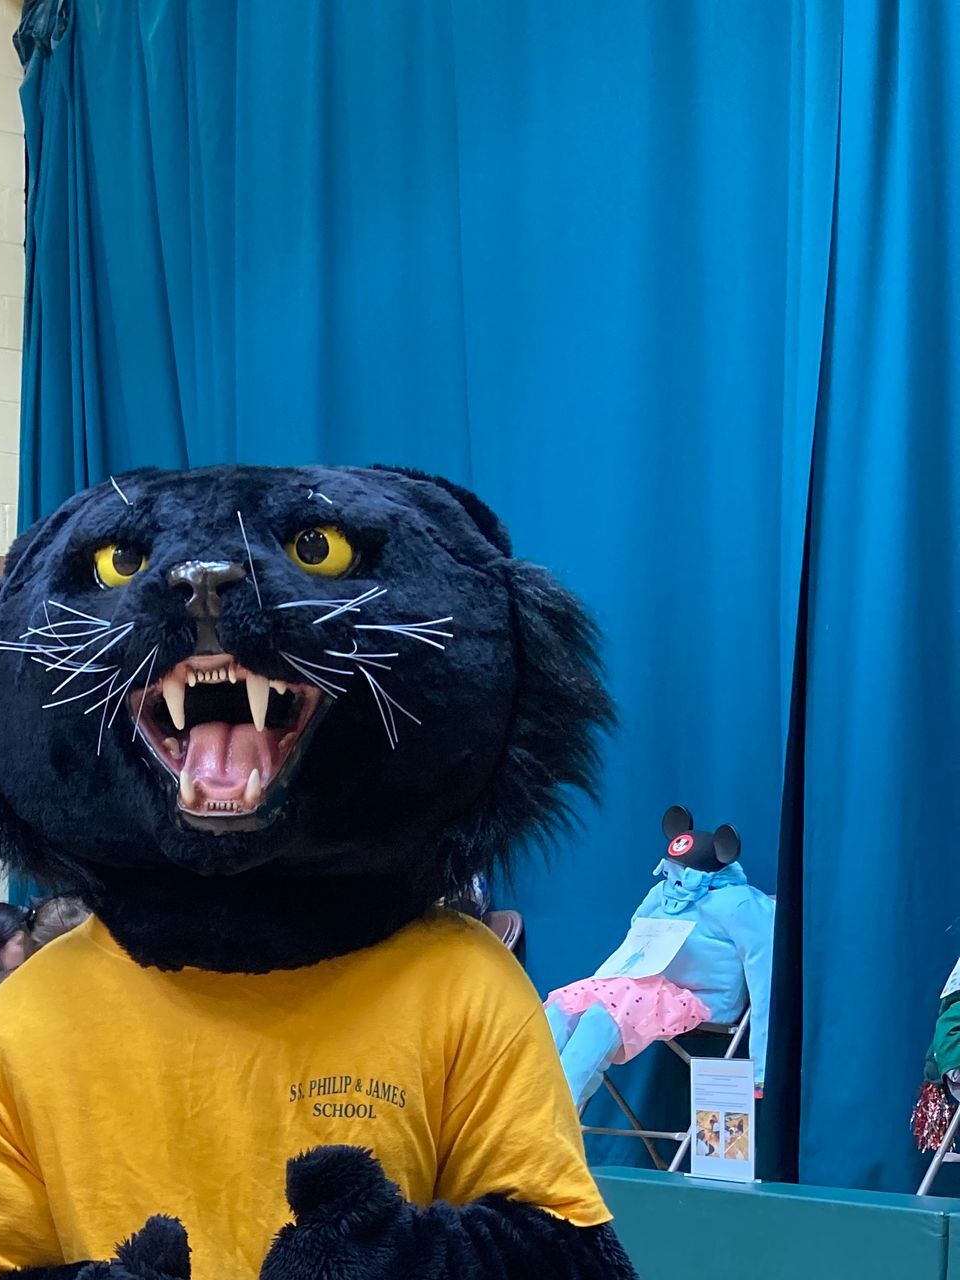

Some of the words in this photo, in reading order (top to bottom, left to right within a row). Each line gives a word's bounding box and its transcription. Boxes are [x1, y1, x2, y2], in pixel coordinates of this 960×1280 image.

[308, 1075, 352, 1098] PHILIP
[354, 1078, 362, 1092] &
[366, 1078, 406, 1108] JAMES
[312, 1102, 377, 1119] SCHOOL
